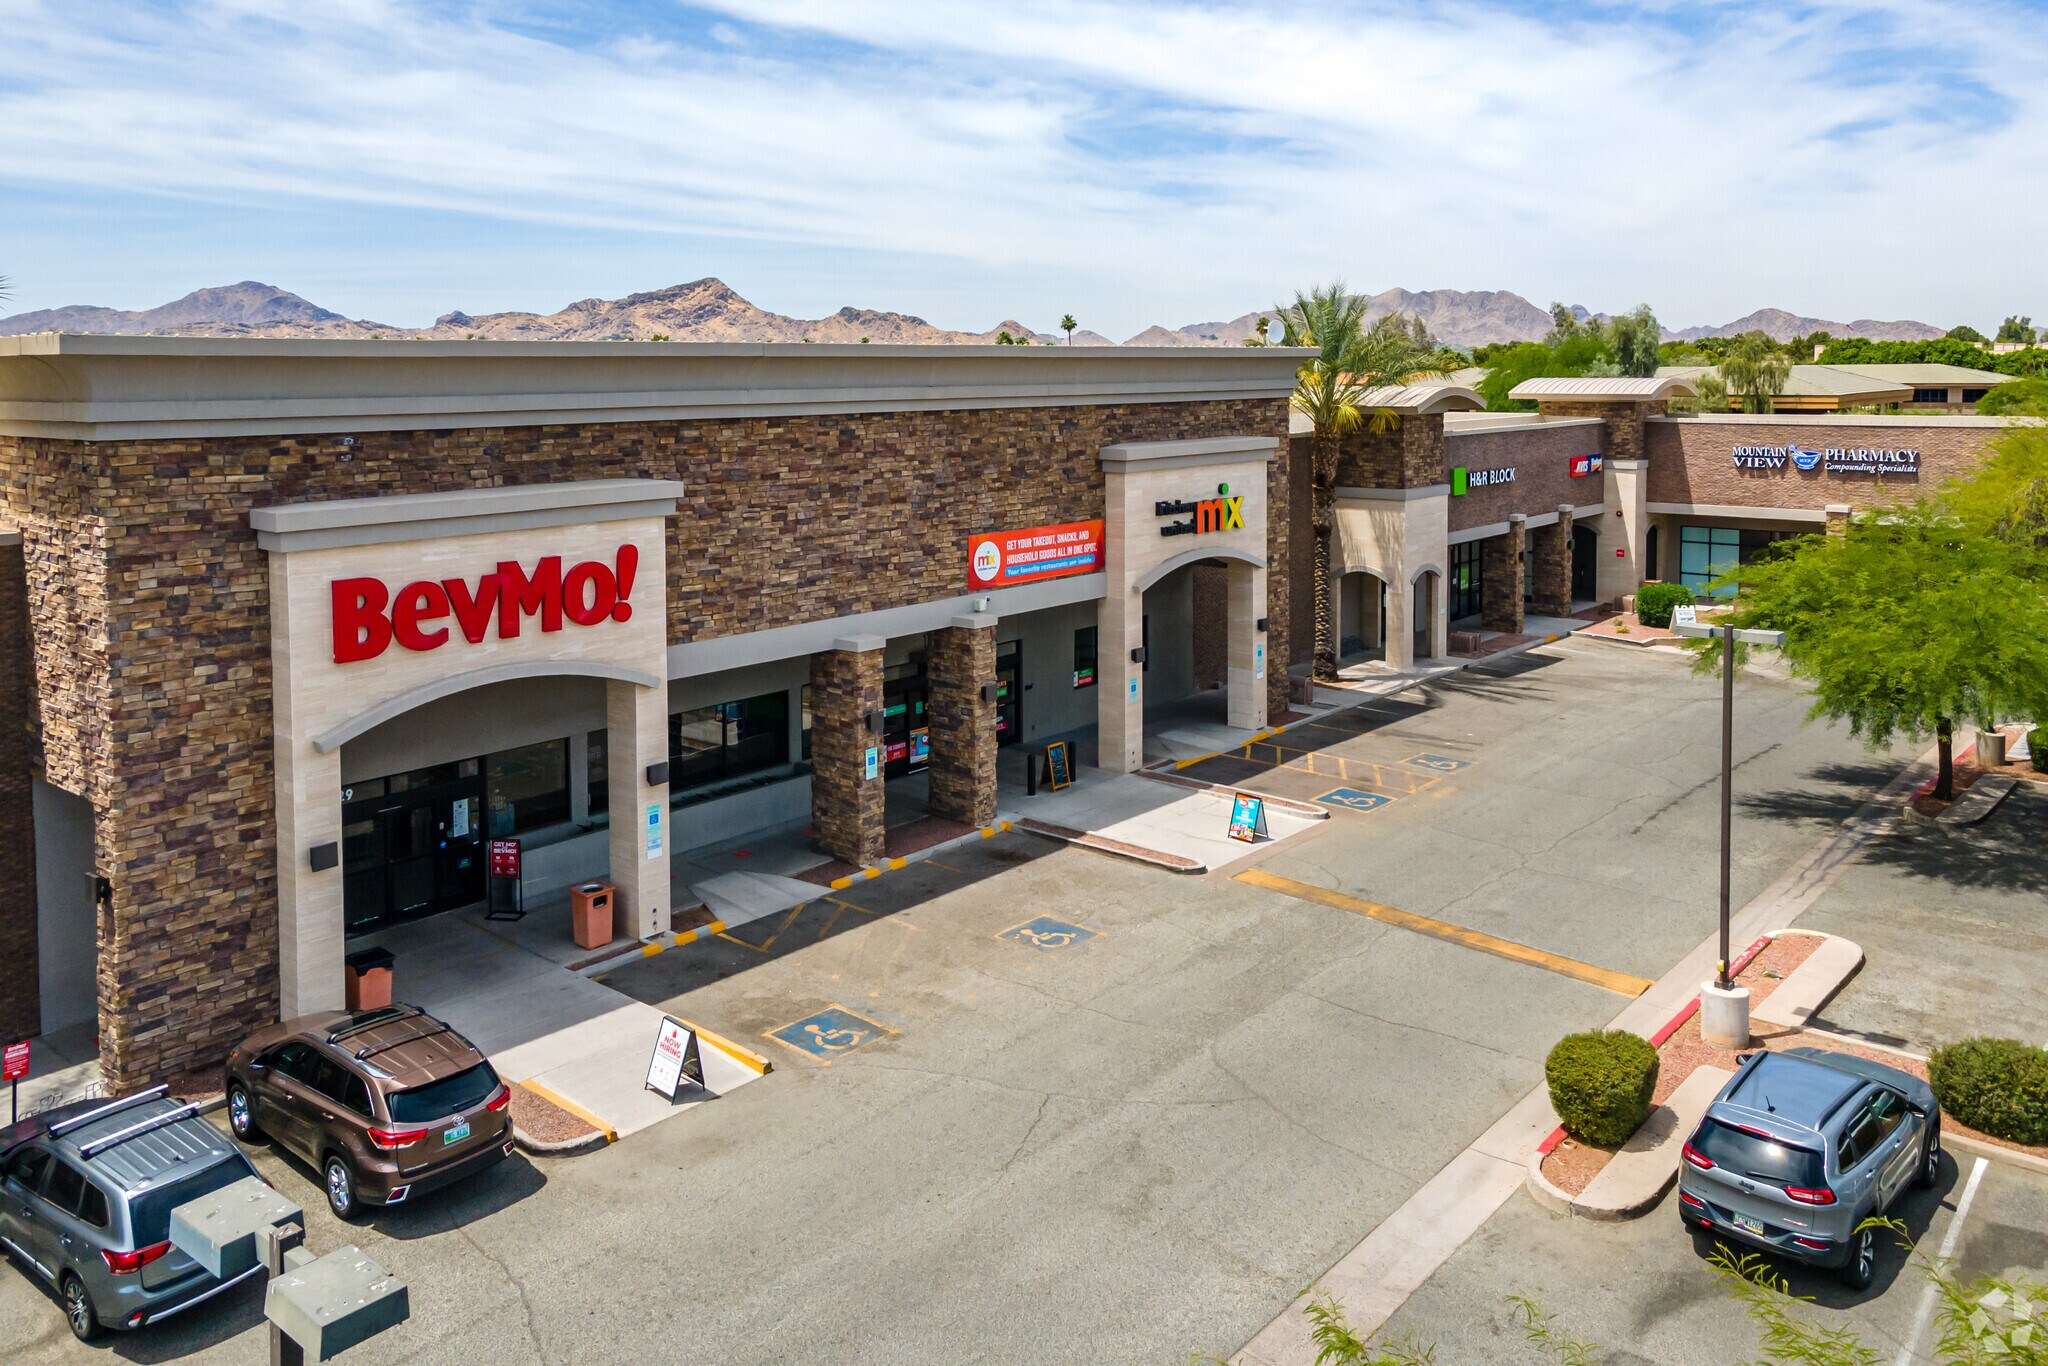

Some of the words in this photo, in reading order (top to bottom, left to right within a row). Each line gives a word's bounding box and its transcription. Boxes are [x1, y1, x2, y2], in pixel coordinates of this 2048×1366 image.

[1732, 446, 1787, 457] MOUNTAIN
[1825, 448, 1917, 463] PHARMACY
[1575, 461, 1589, 473] AVIS
[1733, 457, 1786, 469] VIEW
[1824, 462, 1876, 474] Compounding
[1877, 463, 1917, 474] Specialists
[1469, 471, 1488, 487] H&R
[1489, 467, 1516, 485] BLOCK
[1197, 483, 1245, 535] mix
[1006, 540, 1017, 551] GET
[1017, 538, 1032, 548] YOUR
[1032, 534, 1057, 547] TAKEOUT,
[1057, 532, 1078, 543] SNACKS,
[1078, 530, 1090, 541] AND
[978, 550, 996, 567] mix
[1006, 550, 1039, 564] HOUSEHOLD
[1039, 548, 1057, 560] GOODS
[1057, 547, 1067, 557] ALL
[1067, 546, 1073, 556] IN
[1073, 544, 1084, 555] ONE
[1084, 542, 1098, 553] SPOT.
[1007, 567, 1020, 576] Your
[1020, 564, 1041, 574] favorite
[1041, 561, 1068, 571] restaurants
[331, 544, 639, 664] BevMo!
[660, 1042, 681, 1058] HIRING
[664, 1036, 681, 1049] NOW
